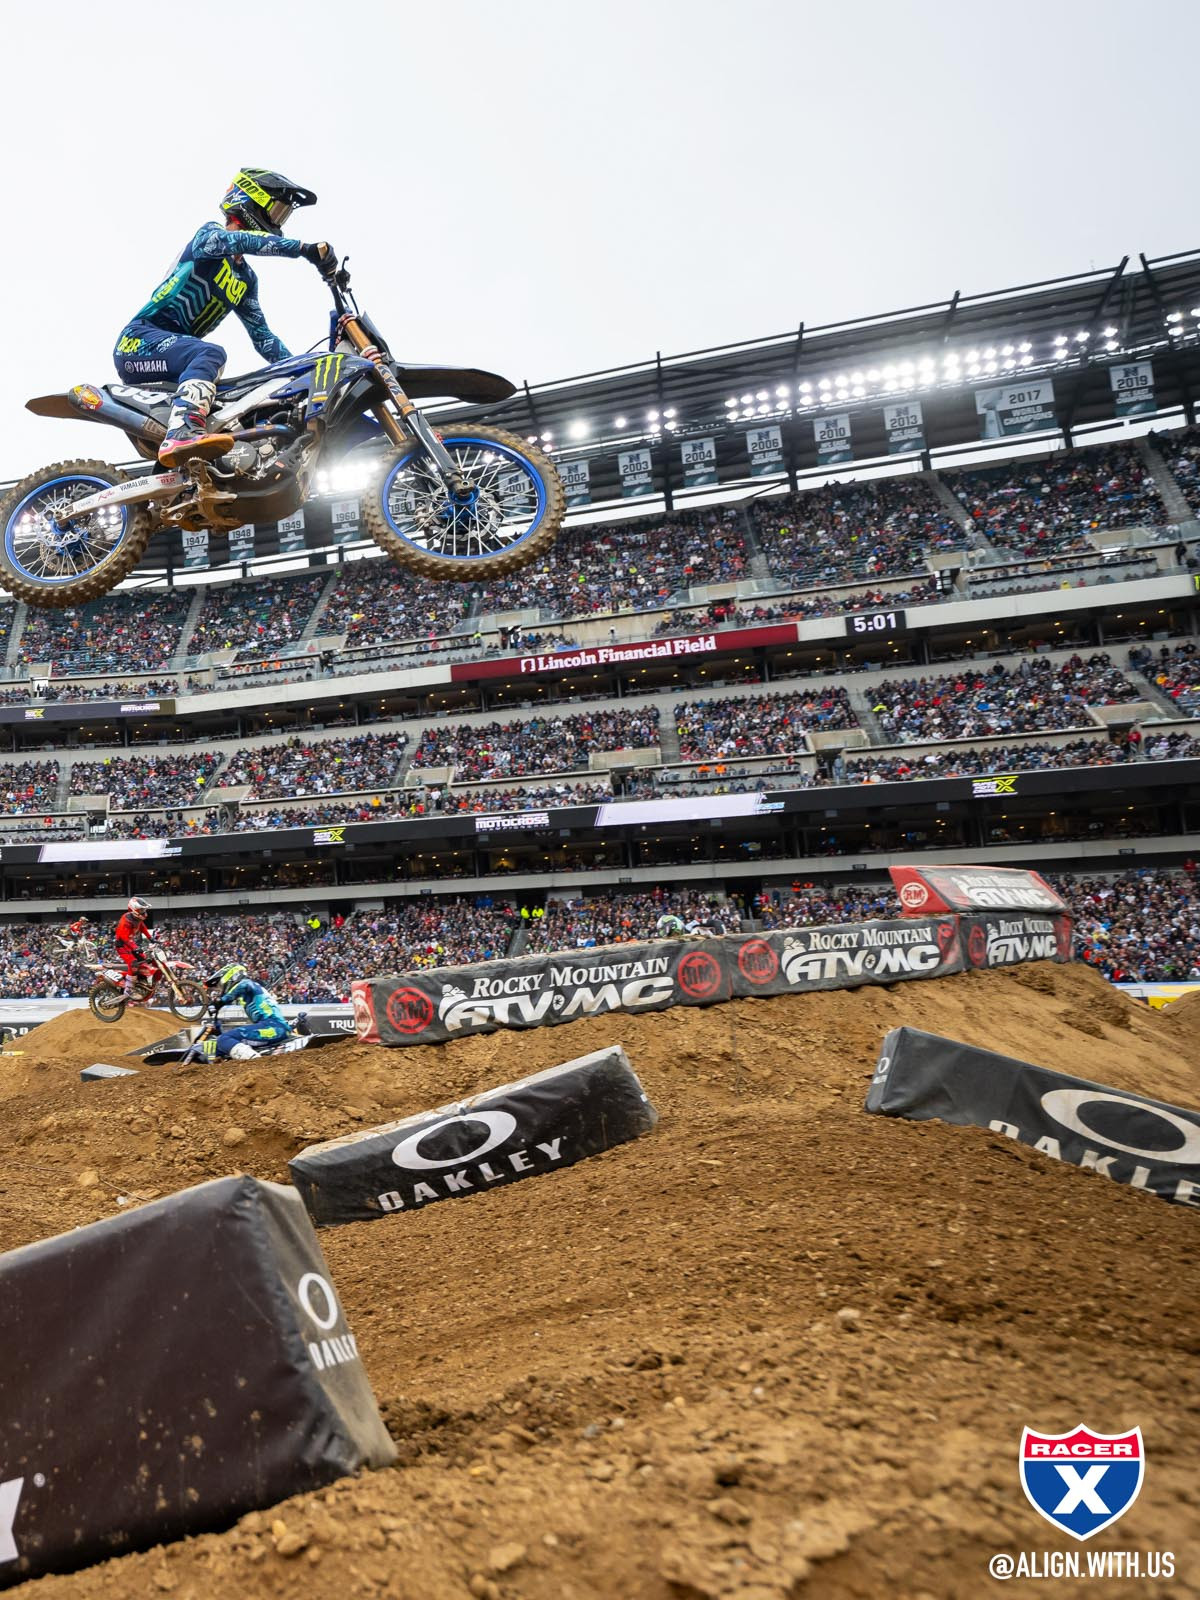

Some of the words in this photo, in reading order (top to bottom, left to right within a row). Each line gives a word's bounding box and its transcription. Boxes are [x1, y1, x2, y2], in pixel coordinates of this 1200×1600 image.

[213, 258, 248, 306] THOR
[134, 360, 168, 373] YAMAHA
[1116, 375, 1148, 389] 2019
[1009, 389, 1041, 404] 2017
[890, 414, 918, 428] 2013
[1003, 411, 1054, 426] CHAMPIONS
[819, 427, 846, 440] 2010
[751, 438, 780, 451] 2006
[684, 450, 713, 463] 2004
[622, 461, 649, 474] 2003
[119, 478, 150, 492] YAMALUBE
[561, 472, 587, 484] 2002
[335, 511, 356, 521] 1960
[281, 520, 301, 531] 1949
[185, 535, 206, 546] 1947
[231, 528, 251, 539] 1948
[853, 612, 897, 634] 5:01
[537, 651, 596, 671] Lincoln
[598, 640, 672, 663] Financial
[673, 636, 716, 655] Field
[475, 815, 550, 829] MOTOCROSS
[808, 932, 860, 951] ROCKY
[861, 927, 933, 947] MOUNTAIN
[471, 973, 544, 999] ROCKY
[549, 956, 669, 987] MOUNTAIN
[377, 1137, 563, 1212] OAKLEY
